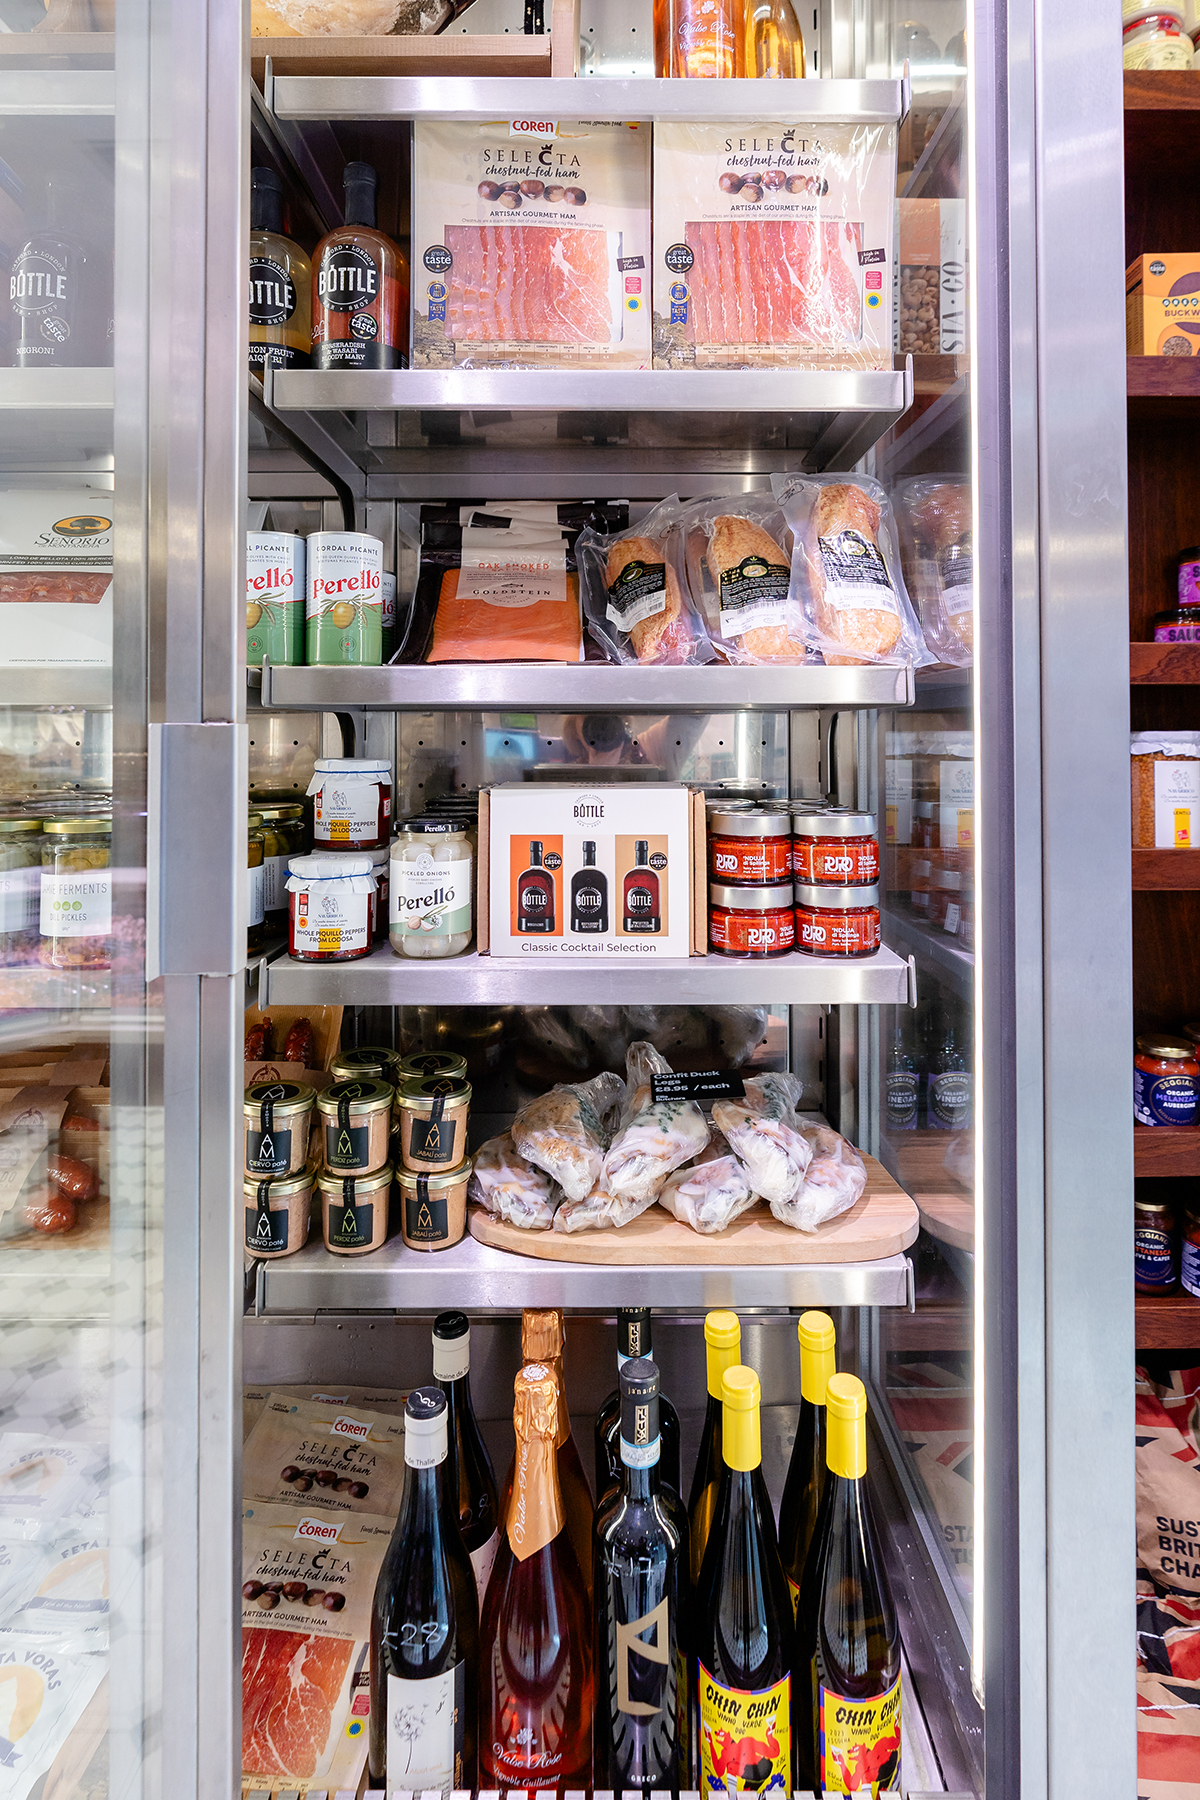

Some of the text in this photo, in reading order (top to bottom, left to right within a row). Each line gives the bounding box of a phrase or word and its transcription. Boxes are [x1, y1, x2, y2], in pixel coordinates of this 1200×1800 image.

[483, 147, 581, 166] SELECTA
[726, 155, 795, 167] chestnut-fed
[485, 166, 580, 179] chestnut-fed ham
[522, 210, 558, 219] GOURMET
[40, 251, 66, 272] LONDON
[351, 245, 375, 266] LONDON
[425, 255, 451, 264] taste
[667, 254, 692, 264] taste
[267, 260, 291, 282] LONDON
[43, 317, 66, 343] taste
[351, 320, 377, 336] taste
[16, 346, 55, 355] NEGRONI
[268, 347, 294, 358] FRUIT
[345, 353, 366, 361] MARY
[255, 545, 290, 553] PICANTE
[350, 545, 378, 556] PICANTE
[505, 562, 550, 570] SMOKED
[313, 569, 380, 599] Perelló
[424, 824, 446, 832] Perelló
[59, 883, 108, 895] FERMENTS
[398, 886, 455, 912] Perelló
[61, 913, 88, 921] PICKLES
[345, 927, 366, 935] PEPPERS
[521, 942, 657, 952] Classic Cocktail Selection
[690, 1070, 720, 1078] Duck
[934, 1094, 970, 1103] VINEGAR
[248, 1159, 287, 1168] CIERVO paté
[346, 1156, 360, 1164] paté
[247, 1236, 284, 1247] CIERVO paté
[1135, 1241, 1165, 1250] ORGANIC
[50, 1448, 78, 1466] VORAS
[299, 1440, 377, 1467] SELECTA
[295, 1453, 372, 1476] chestnut-fed ham
[415, 1458, 436, 1466] Thalie
[279, 1490, 352, 1509] ARTISAN GOURMET HAM
[61, 1539, 100, 1559] FETA
[259, 1550, 352, 1573] SELECTA
[256, 1564, 347, 1585] chestnut-fed ham
[242, 1610, 328, 1626] ARTISAN GOURMET HAM
[24, 1650, 62, 1691] VORAS
[706, 1684, 782, 1719] CHIN CHIN
[717, 1710, 763, 1728] VINHO VERDE
[835, 1706, 877, 1727] CHIN
[851, 1727, 872, 1736] VINHO
[492, 1742, 563, 1770] Valse Rose
[493, 1764, 561, 1788] Vignoble Guillaume
[630, 1774, 657, 1782] GRECO
